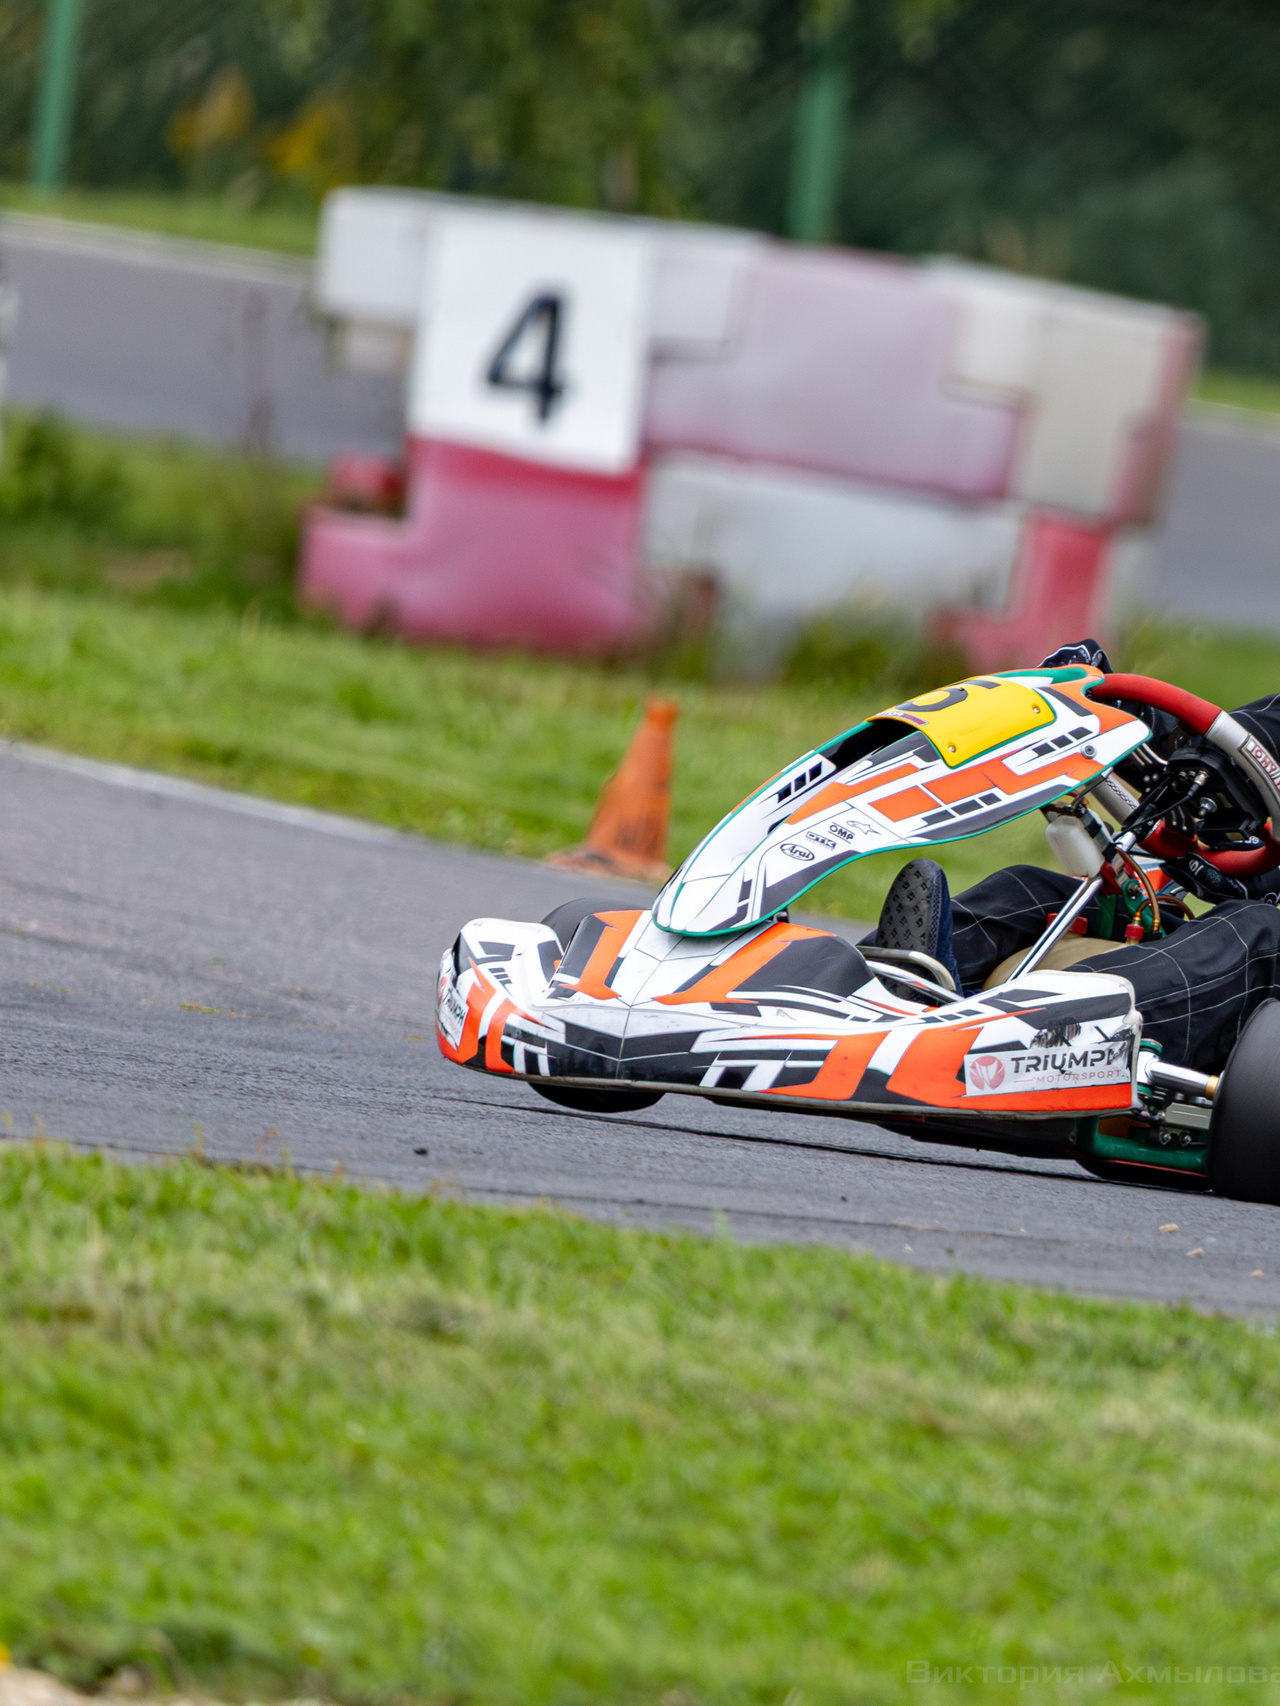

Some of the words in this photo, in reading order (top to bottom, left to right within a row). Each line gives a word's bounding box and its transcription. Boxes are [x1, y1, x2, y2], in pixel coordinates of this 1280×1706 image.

[484, 289, 566, 424] 4
[829, 824, 854, 840] OMP
[783, 844, 811, 859] Arai
[1035, 1069, 1122, 1084] MOTORSPORT
